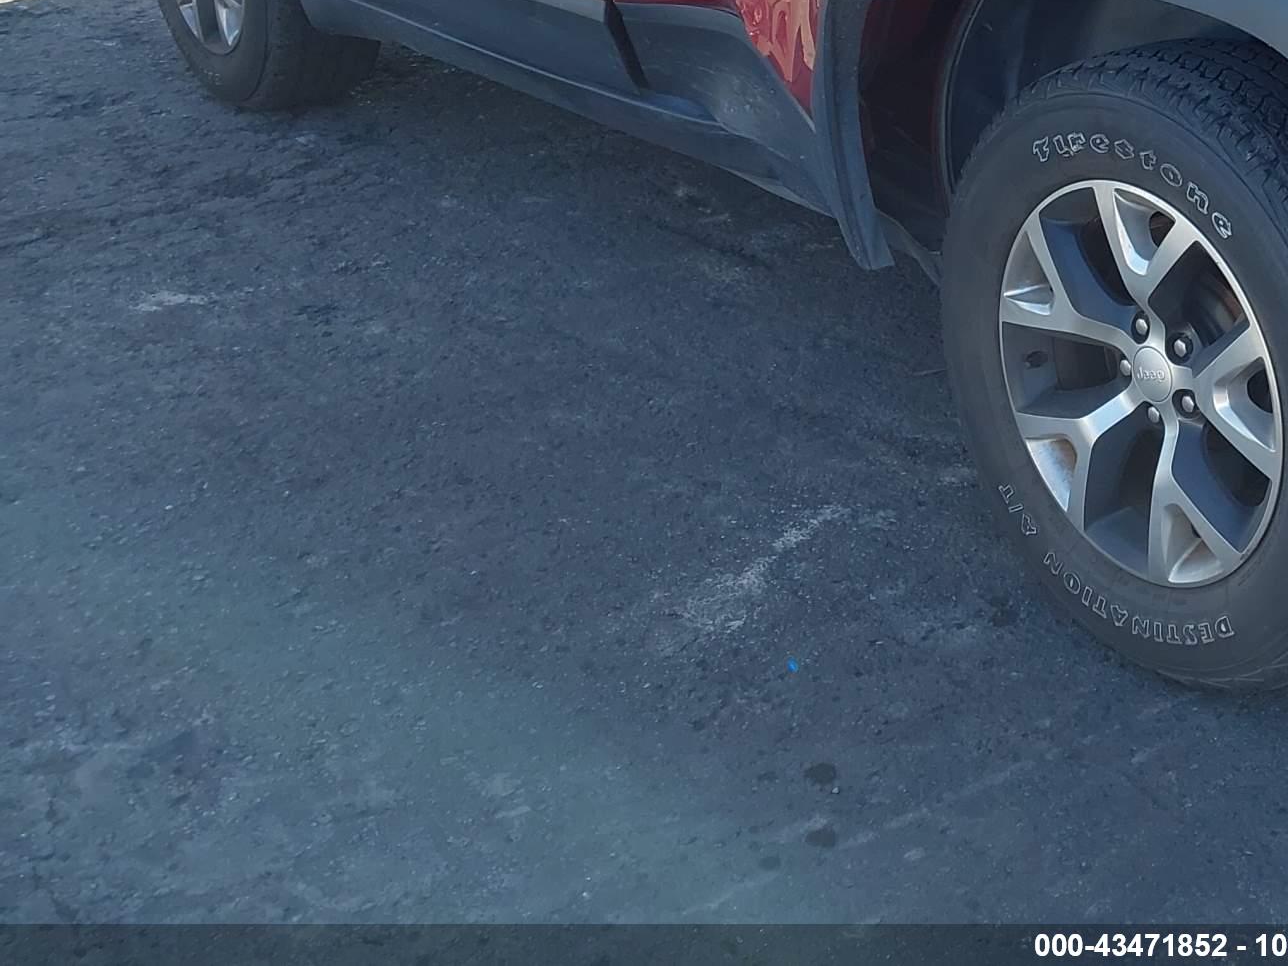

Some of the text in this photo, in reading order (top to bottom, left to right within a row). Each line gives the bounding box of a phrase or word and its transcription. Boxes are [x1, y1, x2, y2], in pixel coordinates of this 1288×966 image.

[1033, 133, 1232, 239] Firestone
[1137, 366, 1165, 383] Jeep
[998, 483, 1234, 645] DESTINATION A/T
